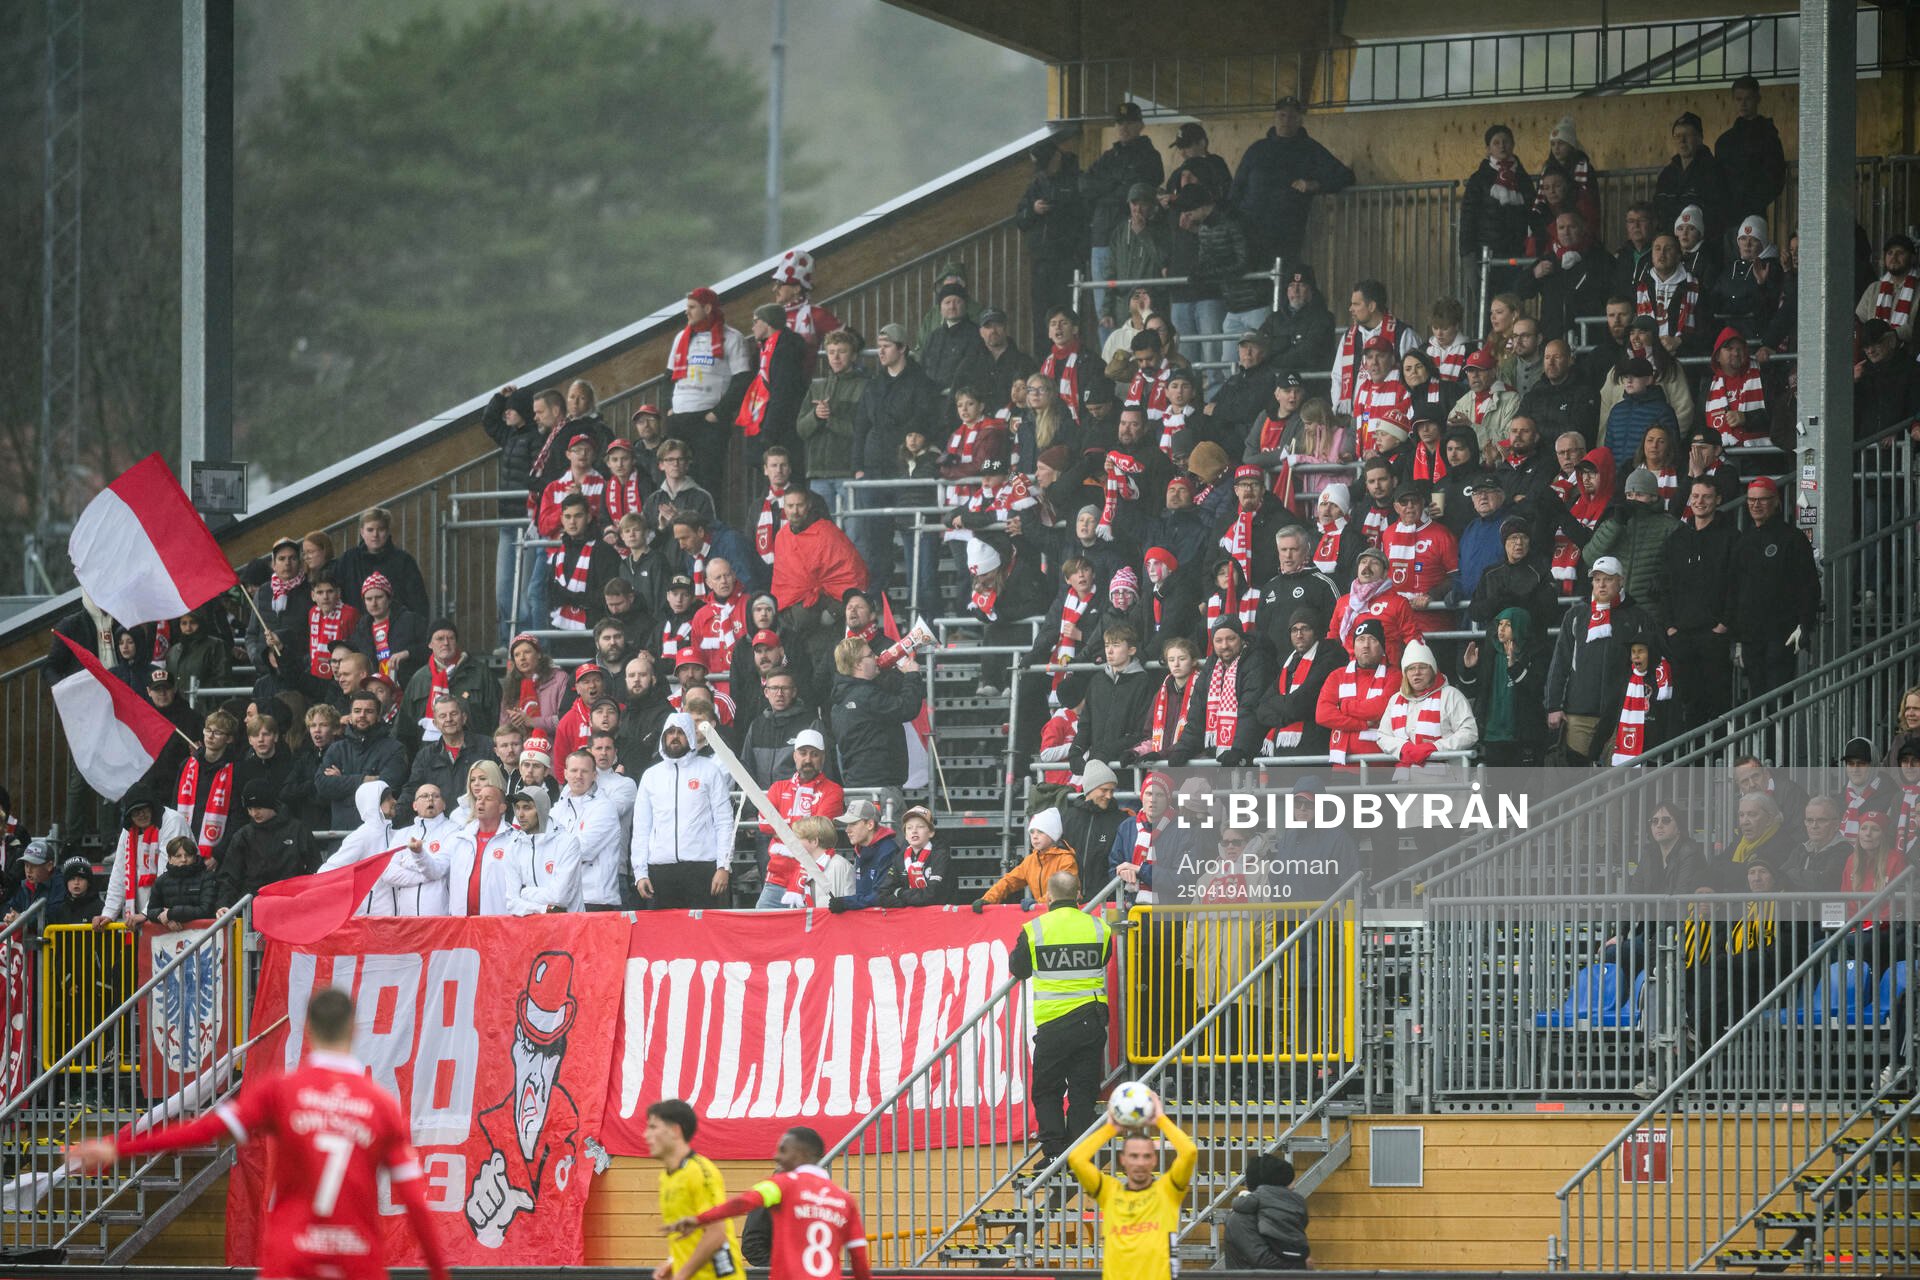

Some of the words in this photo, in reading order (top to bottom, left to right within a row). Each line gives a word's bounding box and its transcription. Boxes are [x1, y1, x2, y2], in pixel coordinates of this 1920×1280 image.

[1042, 947, 1100, 969] VÄRD
[1626, 1132, 1667, 1143] SEKTON
[313, 1132, 353, 1218] 7
[802, 1220, 833, 1278] 8
